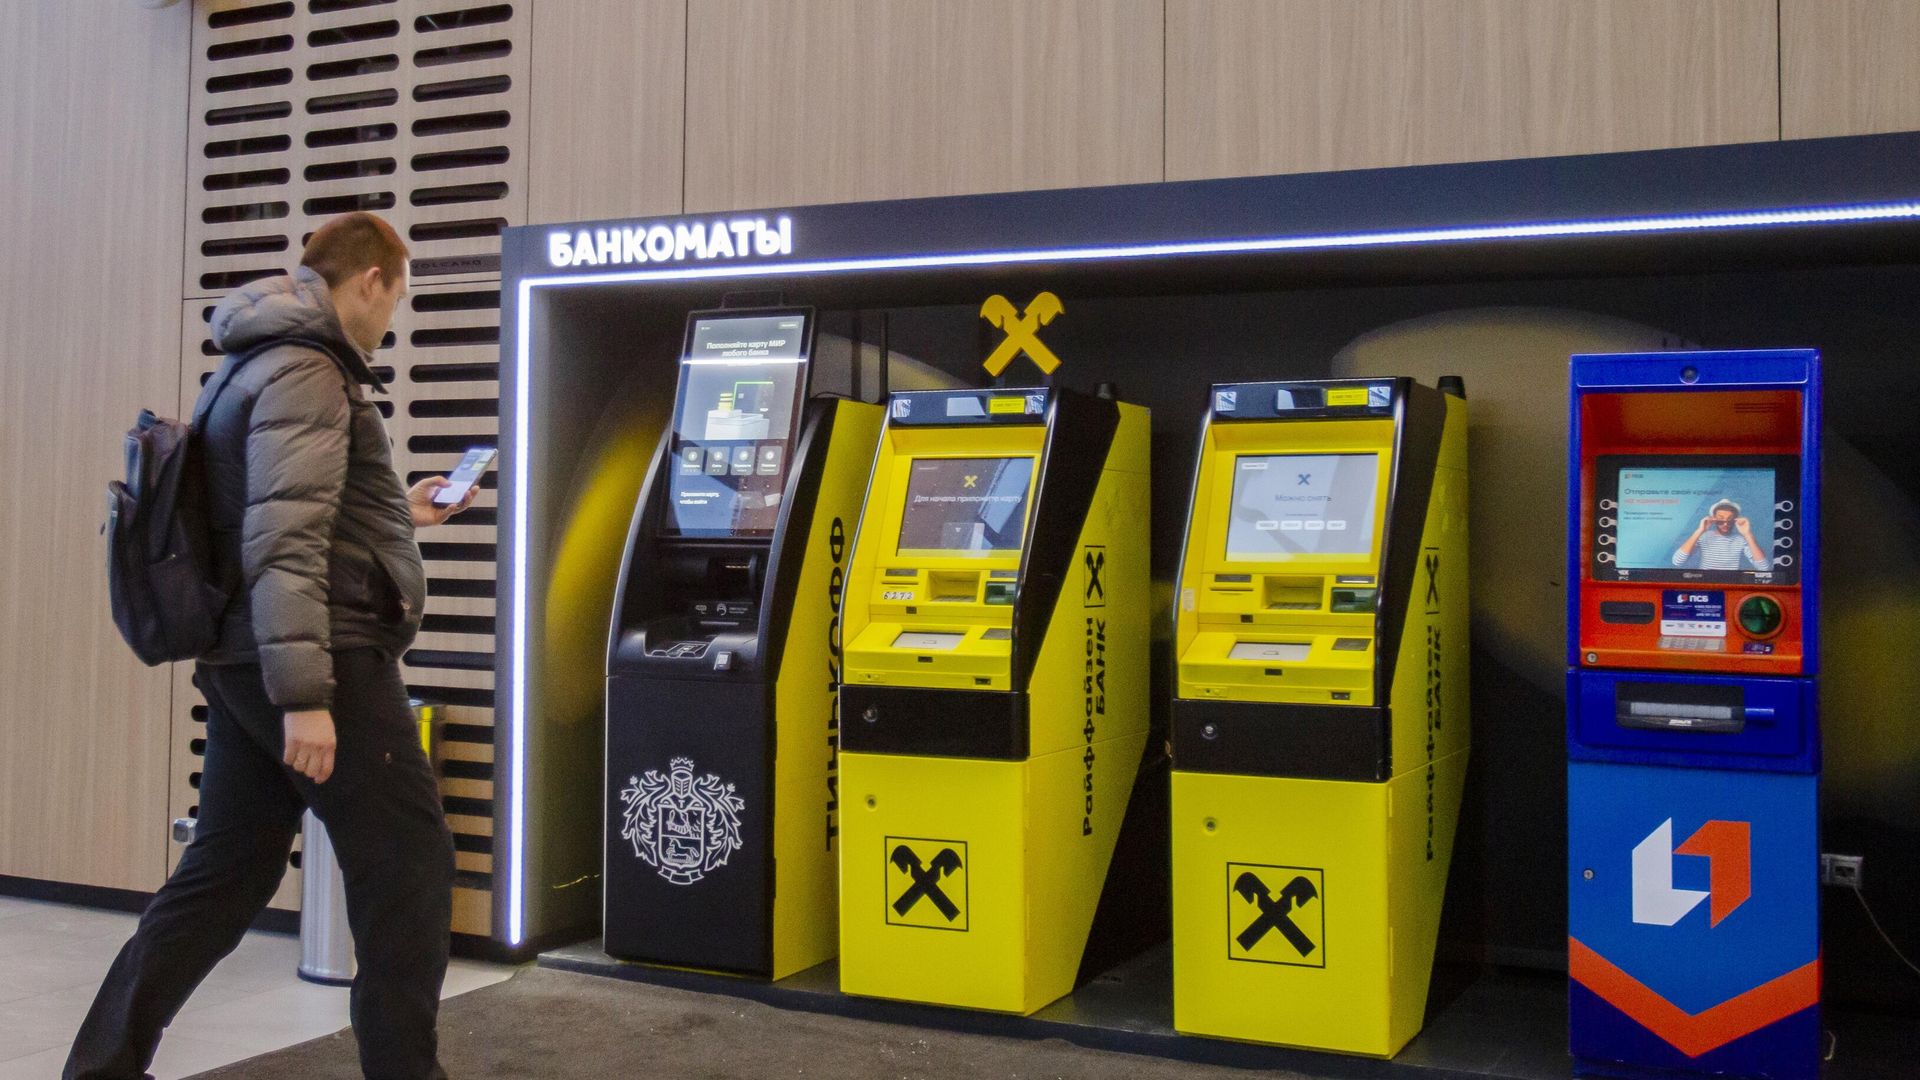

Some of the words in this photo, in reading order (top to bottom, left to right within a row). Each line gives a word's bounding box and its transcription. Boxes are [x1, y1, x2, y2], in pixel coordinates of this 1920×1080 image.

[549, 217, 792, 267] БАНКОМАТЫ
[748, 341, 768, 349] карту
[768, 339, 786, 348] МИР
[913, 494, 929, 503] Для
[1689, 594, 1709, 603] ПСБ
[1096, 617, 1105, 716] БАНК
[1083, 617, 1095, 837] Райффайзен
